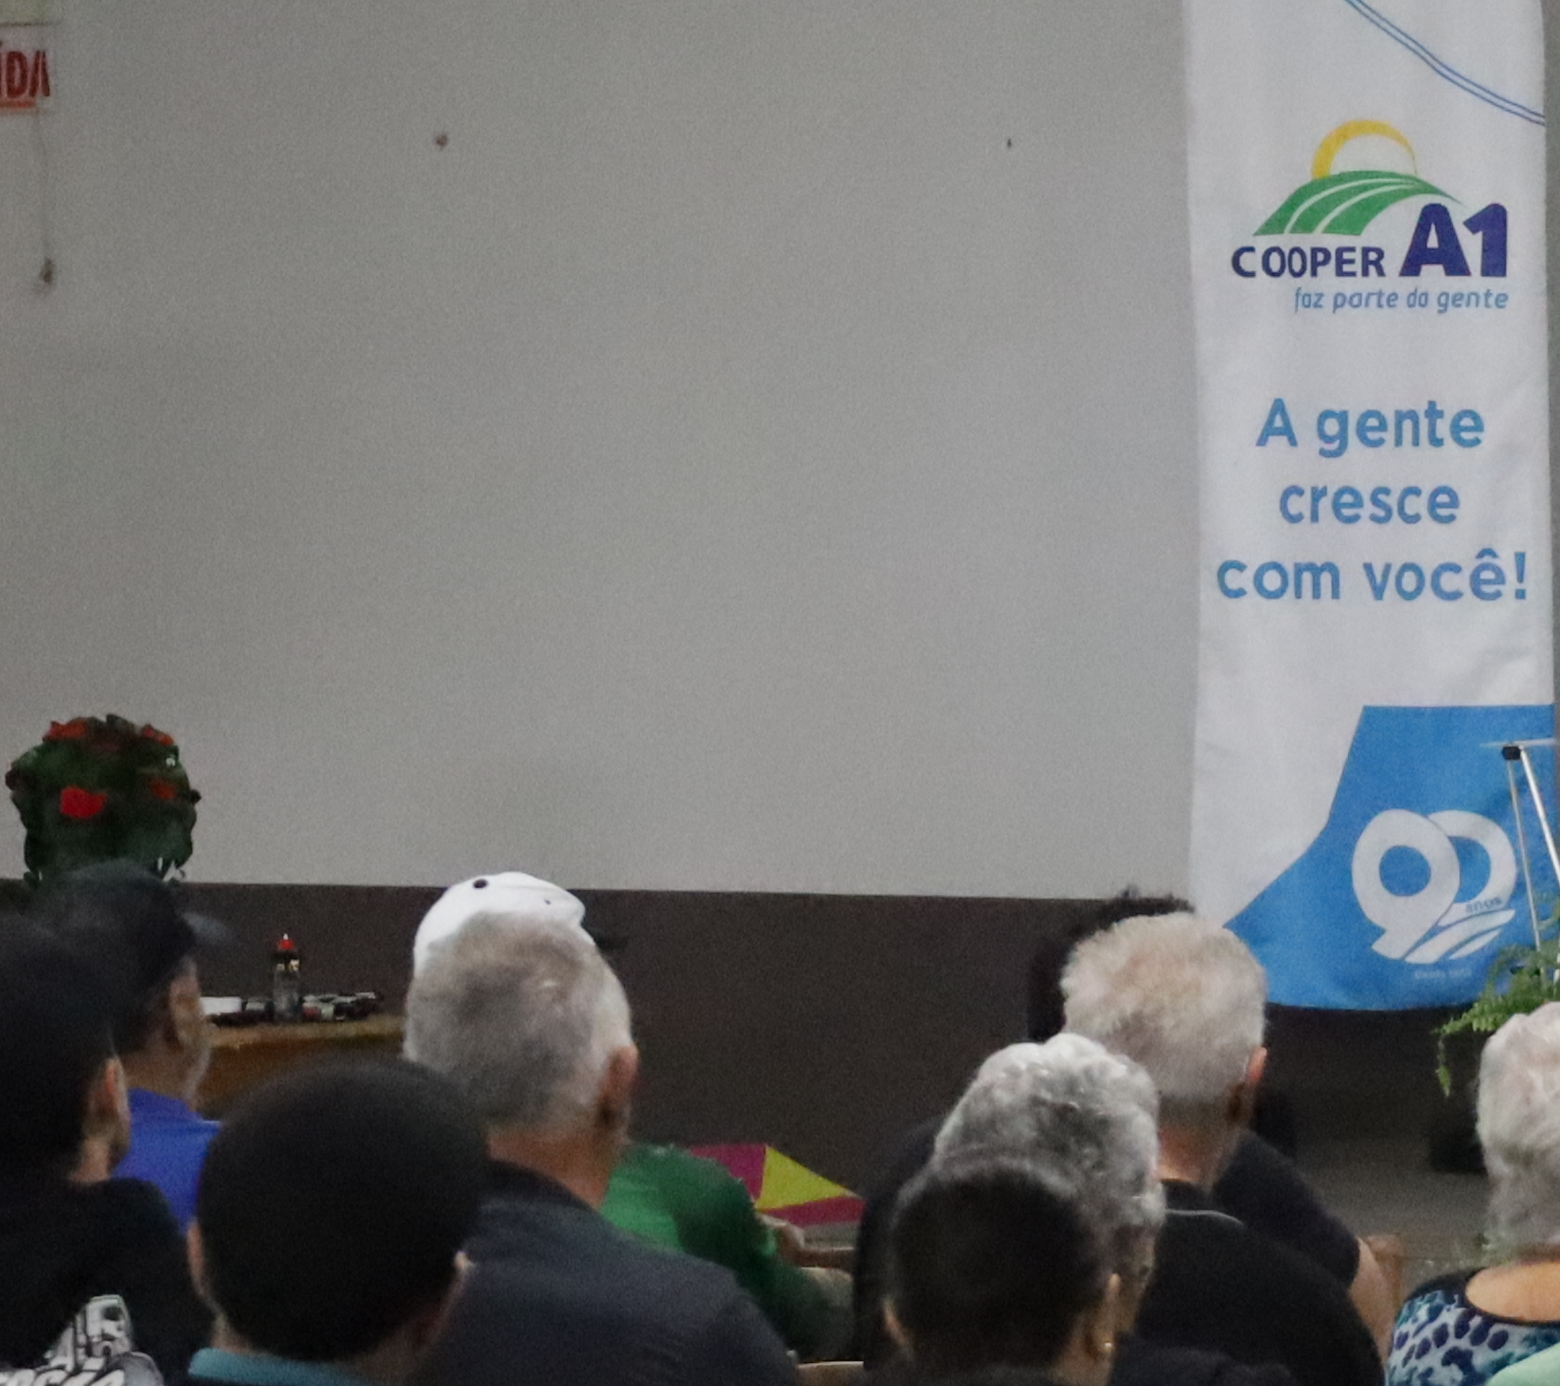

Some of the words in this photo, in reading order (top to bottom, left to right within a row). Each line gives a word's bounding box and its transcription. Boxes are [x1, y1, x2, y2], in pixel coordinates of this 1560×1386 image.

[1230, 244, 1386, 279] COOPER
[1398, 201, 1510, 278] A1
[1293, 286, 1324, 314] faz
[1333, 288, 1400, 314] parte
[1406, 287, 1430, 310] da
[1436, 289, 1510, 315] gente
[1255, 397, 1299, 447] A
[1316, 399, 1486, 459] gente
[1279, 483, 1461, 525] cresce
[1215, 558, 1341, 601] com
[1362, 547, 1529, 602] você!
